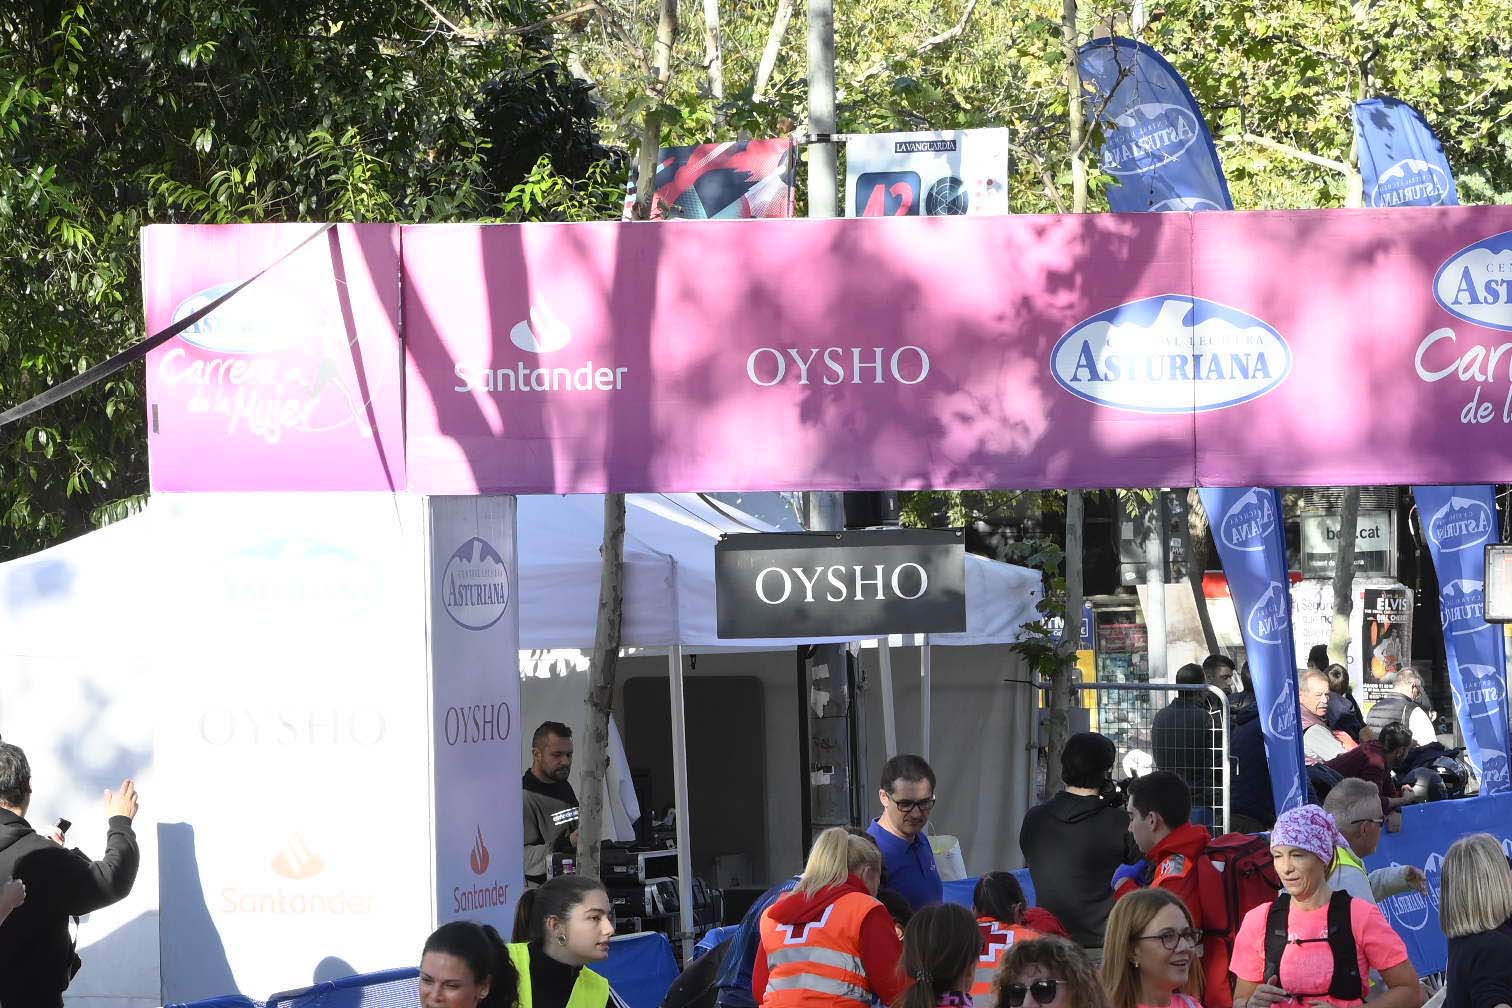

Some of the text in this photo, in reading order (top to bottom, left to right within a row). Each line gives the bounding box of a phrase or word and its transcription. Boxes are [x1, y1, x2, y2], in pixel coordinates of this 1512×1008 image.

[454, 360, 628, 392] Santander
[746, 345, 930, 387] OYSHO
[1069, 339, 1273, 382] ASTURIANA
[1460, 385, 1495, 424] de
[447, 572, 506, 607] ASTURIANA
[755, 562, 929, 605] OYSHO
[1377, 598, 1408, 611] ELVIS
[445, 701, 511, 746] OYSHO
[454, 880, 509, 913] Santander
